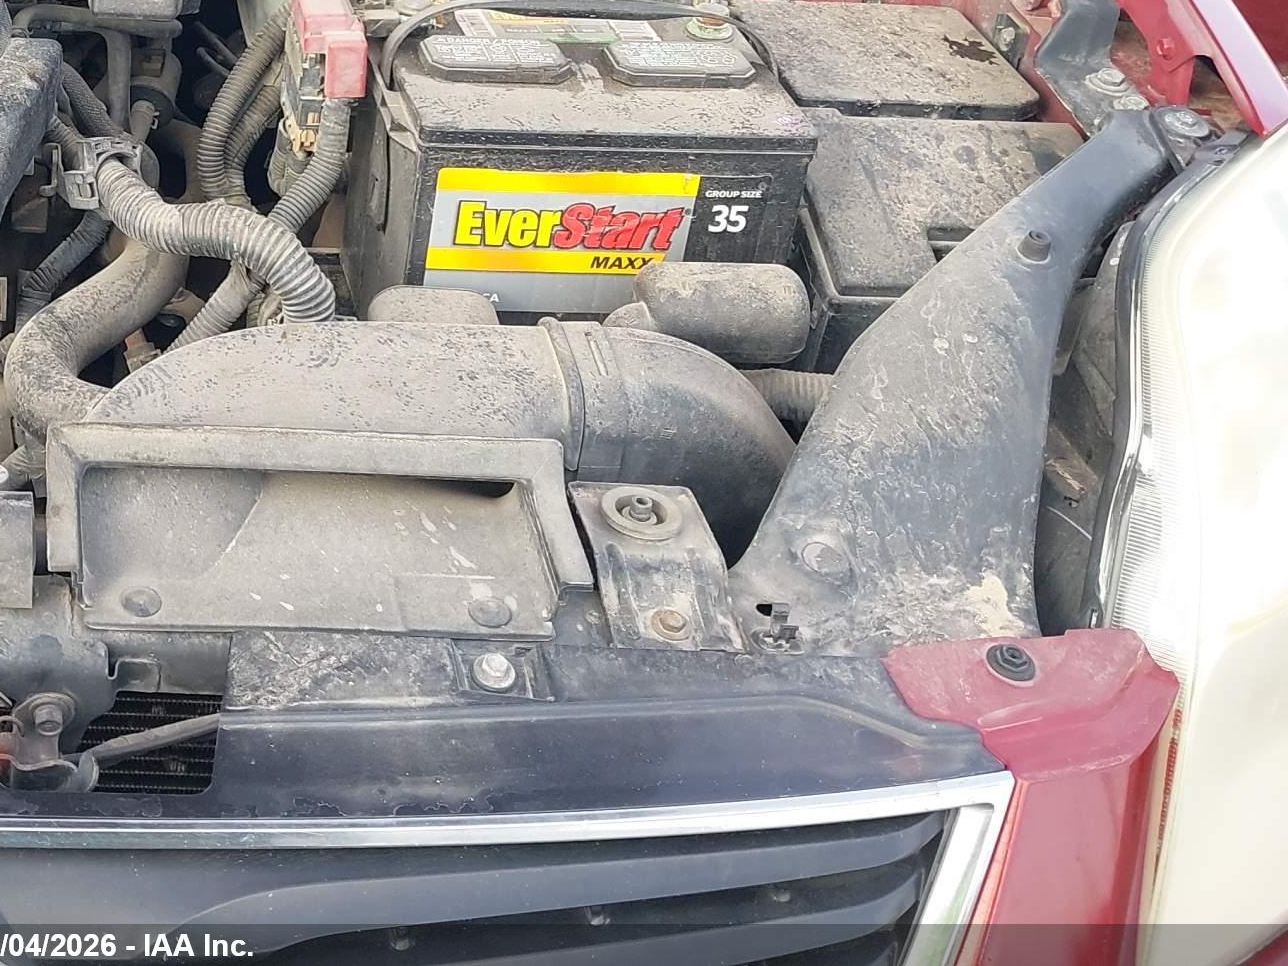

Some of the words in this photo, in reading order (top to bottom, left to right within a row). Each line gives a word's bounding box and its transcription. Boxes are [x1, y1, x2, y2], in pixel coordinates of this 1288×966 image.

[705, 190, 743, 199] GROUP
[744, 190, 763, 199] SIZE
[453, 199, 686, 252] EverStart
[708, 204, 750, 234] 35
